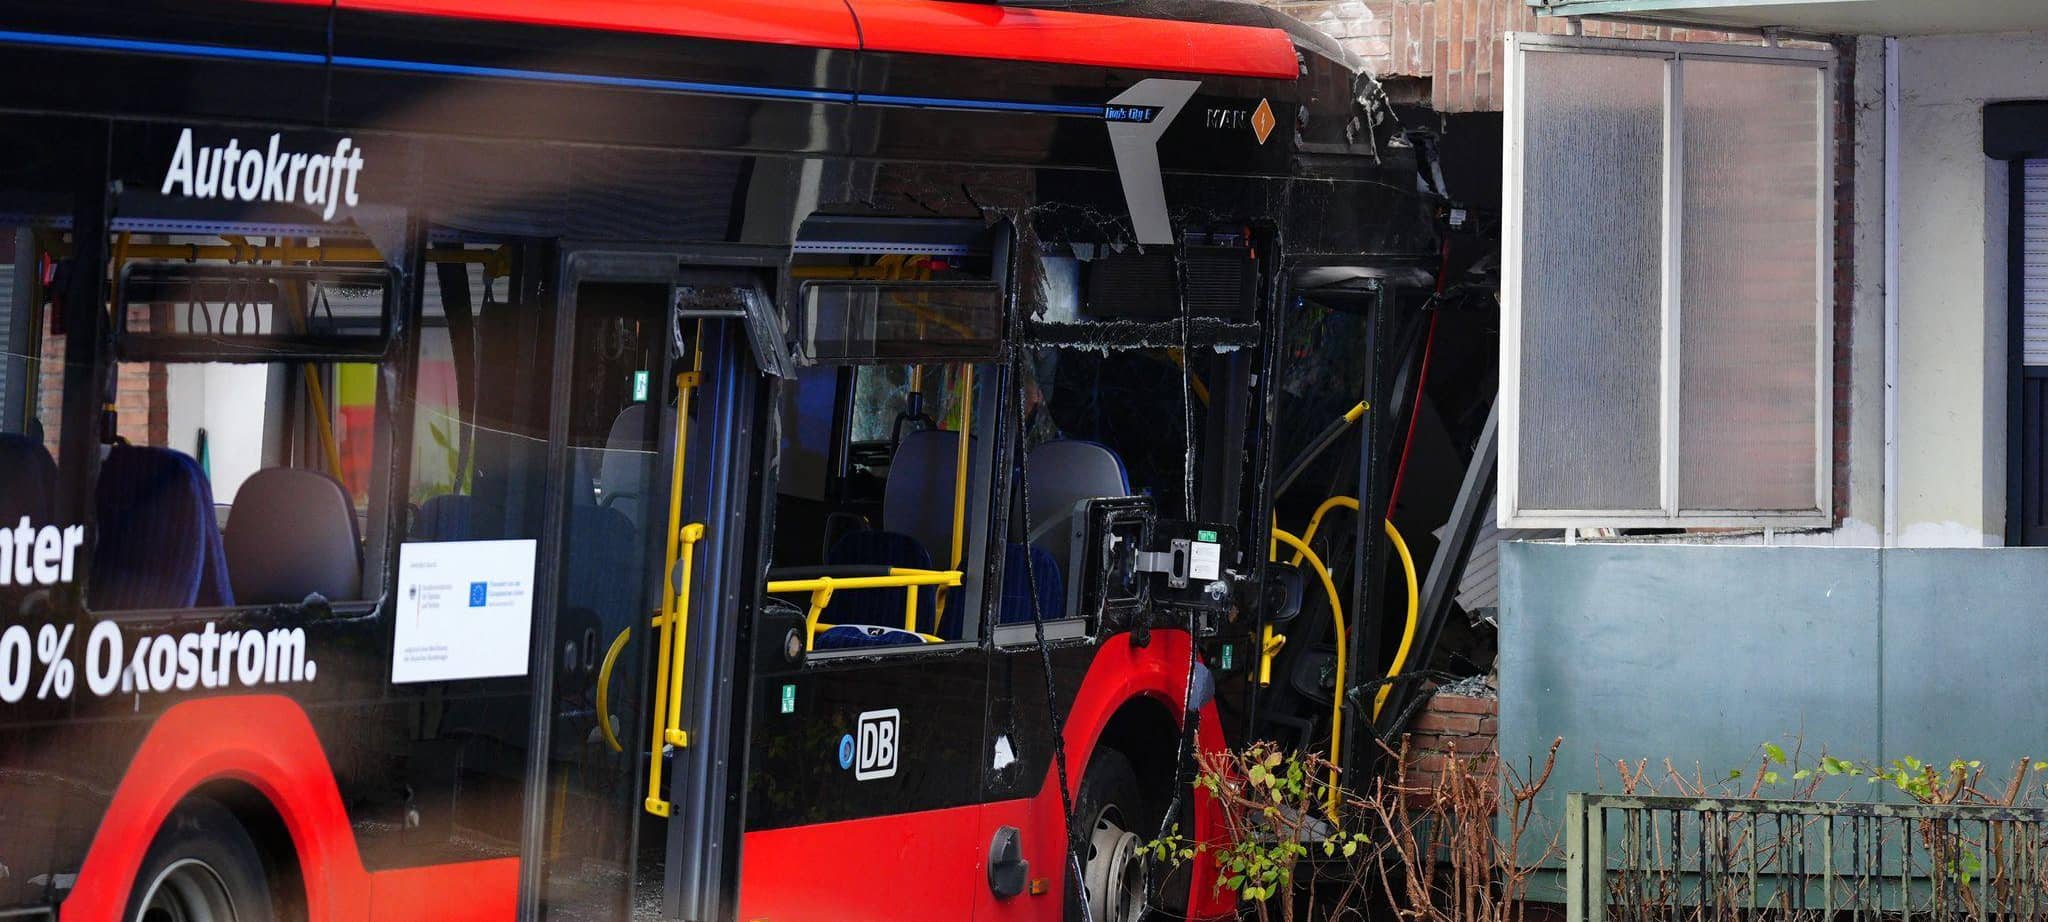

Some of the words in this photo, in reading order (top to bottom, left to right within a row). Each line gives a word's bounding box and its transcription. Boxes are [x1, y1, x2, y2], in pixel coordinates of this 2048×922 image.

[1128, 107, 1143, 121] City
[1207, 108, 1247, 128] MAN
[161, 127, 364, 221] Autokraft
[861, 721, 893, 769] DB
